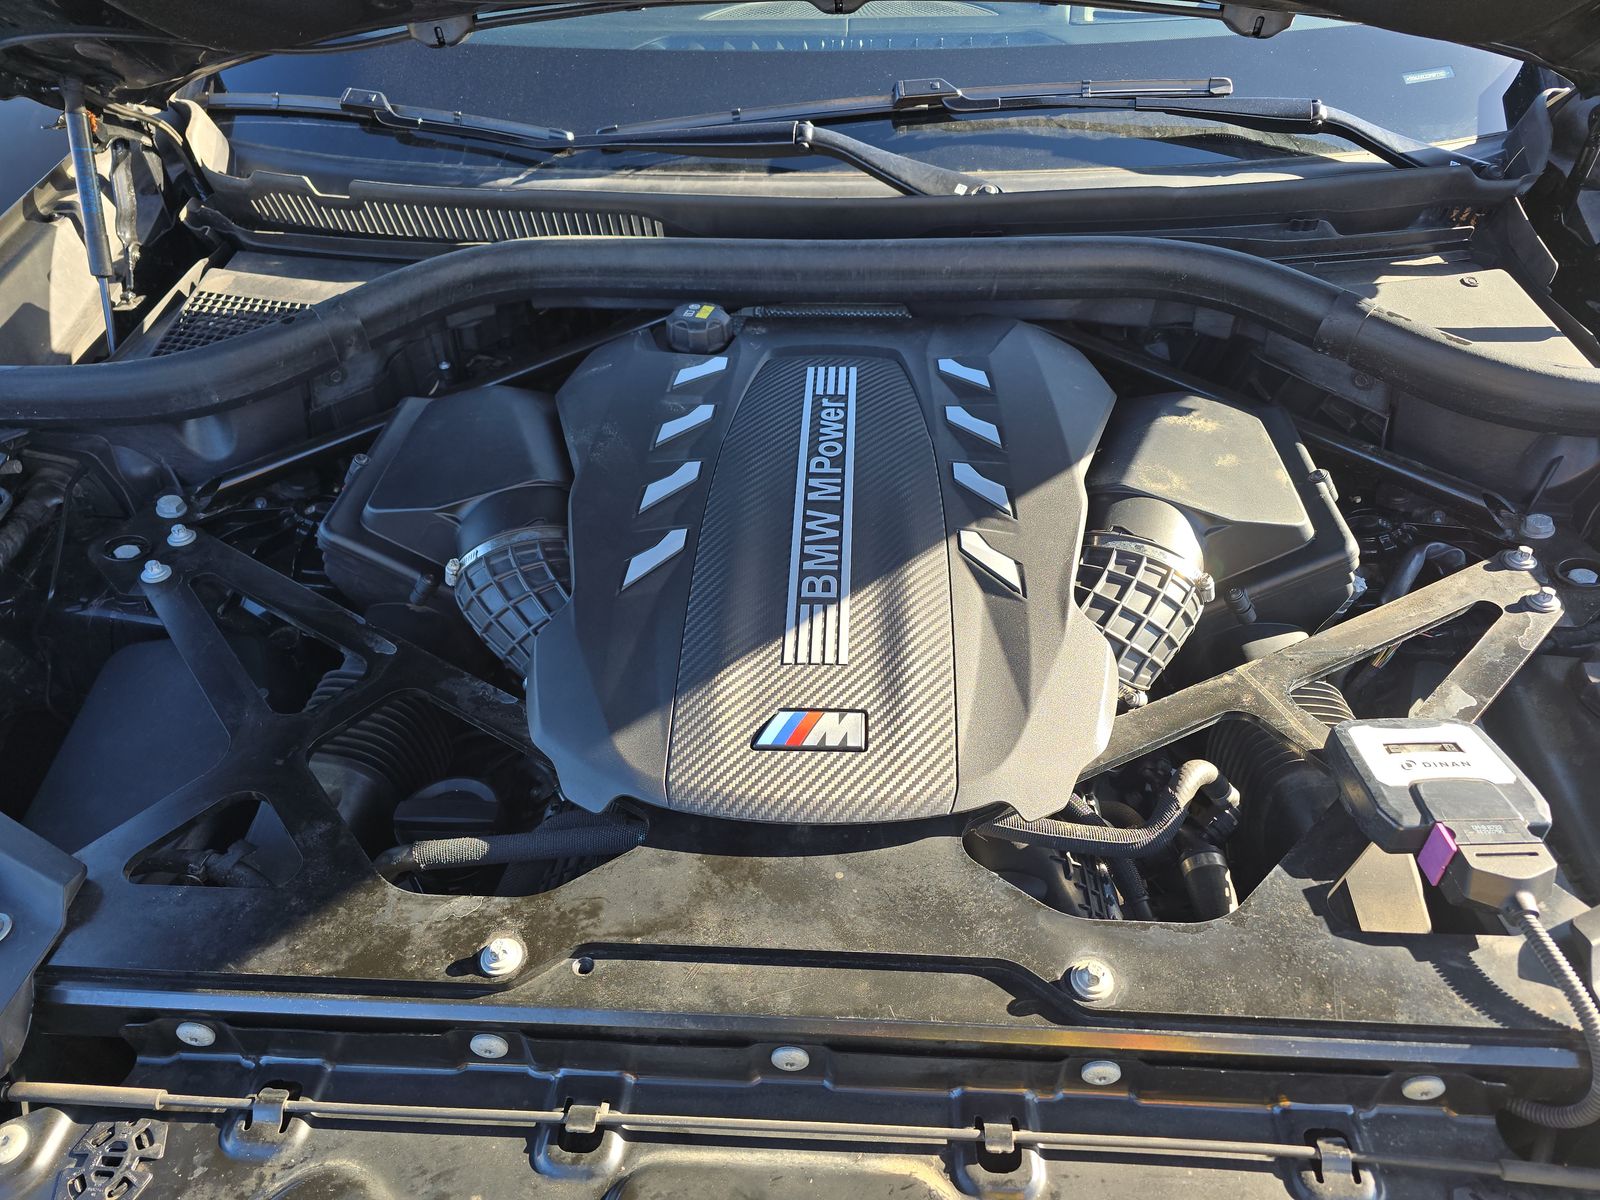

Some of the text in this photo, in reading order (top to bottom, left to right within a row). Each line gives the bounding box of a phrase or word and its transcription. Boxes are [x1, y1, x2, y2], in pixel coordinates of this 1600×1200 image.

[800, 398, 846, 598] BMW MPower
[802, 711, 862, 746] M
[1421, 760, 1472, 768] DINAN
